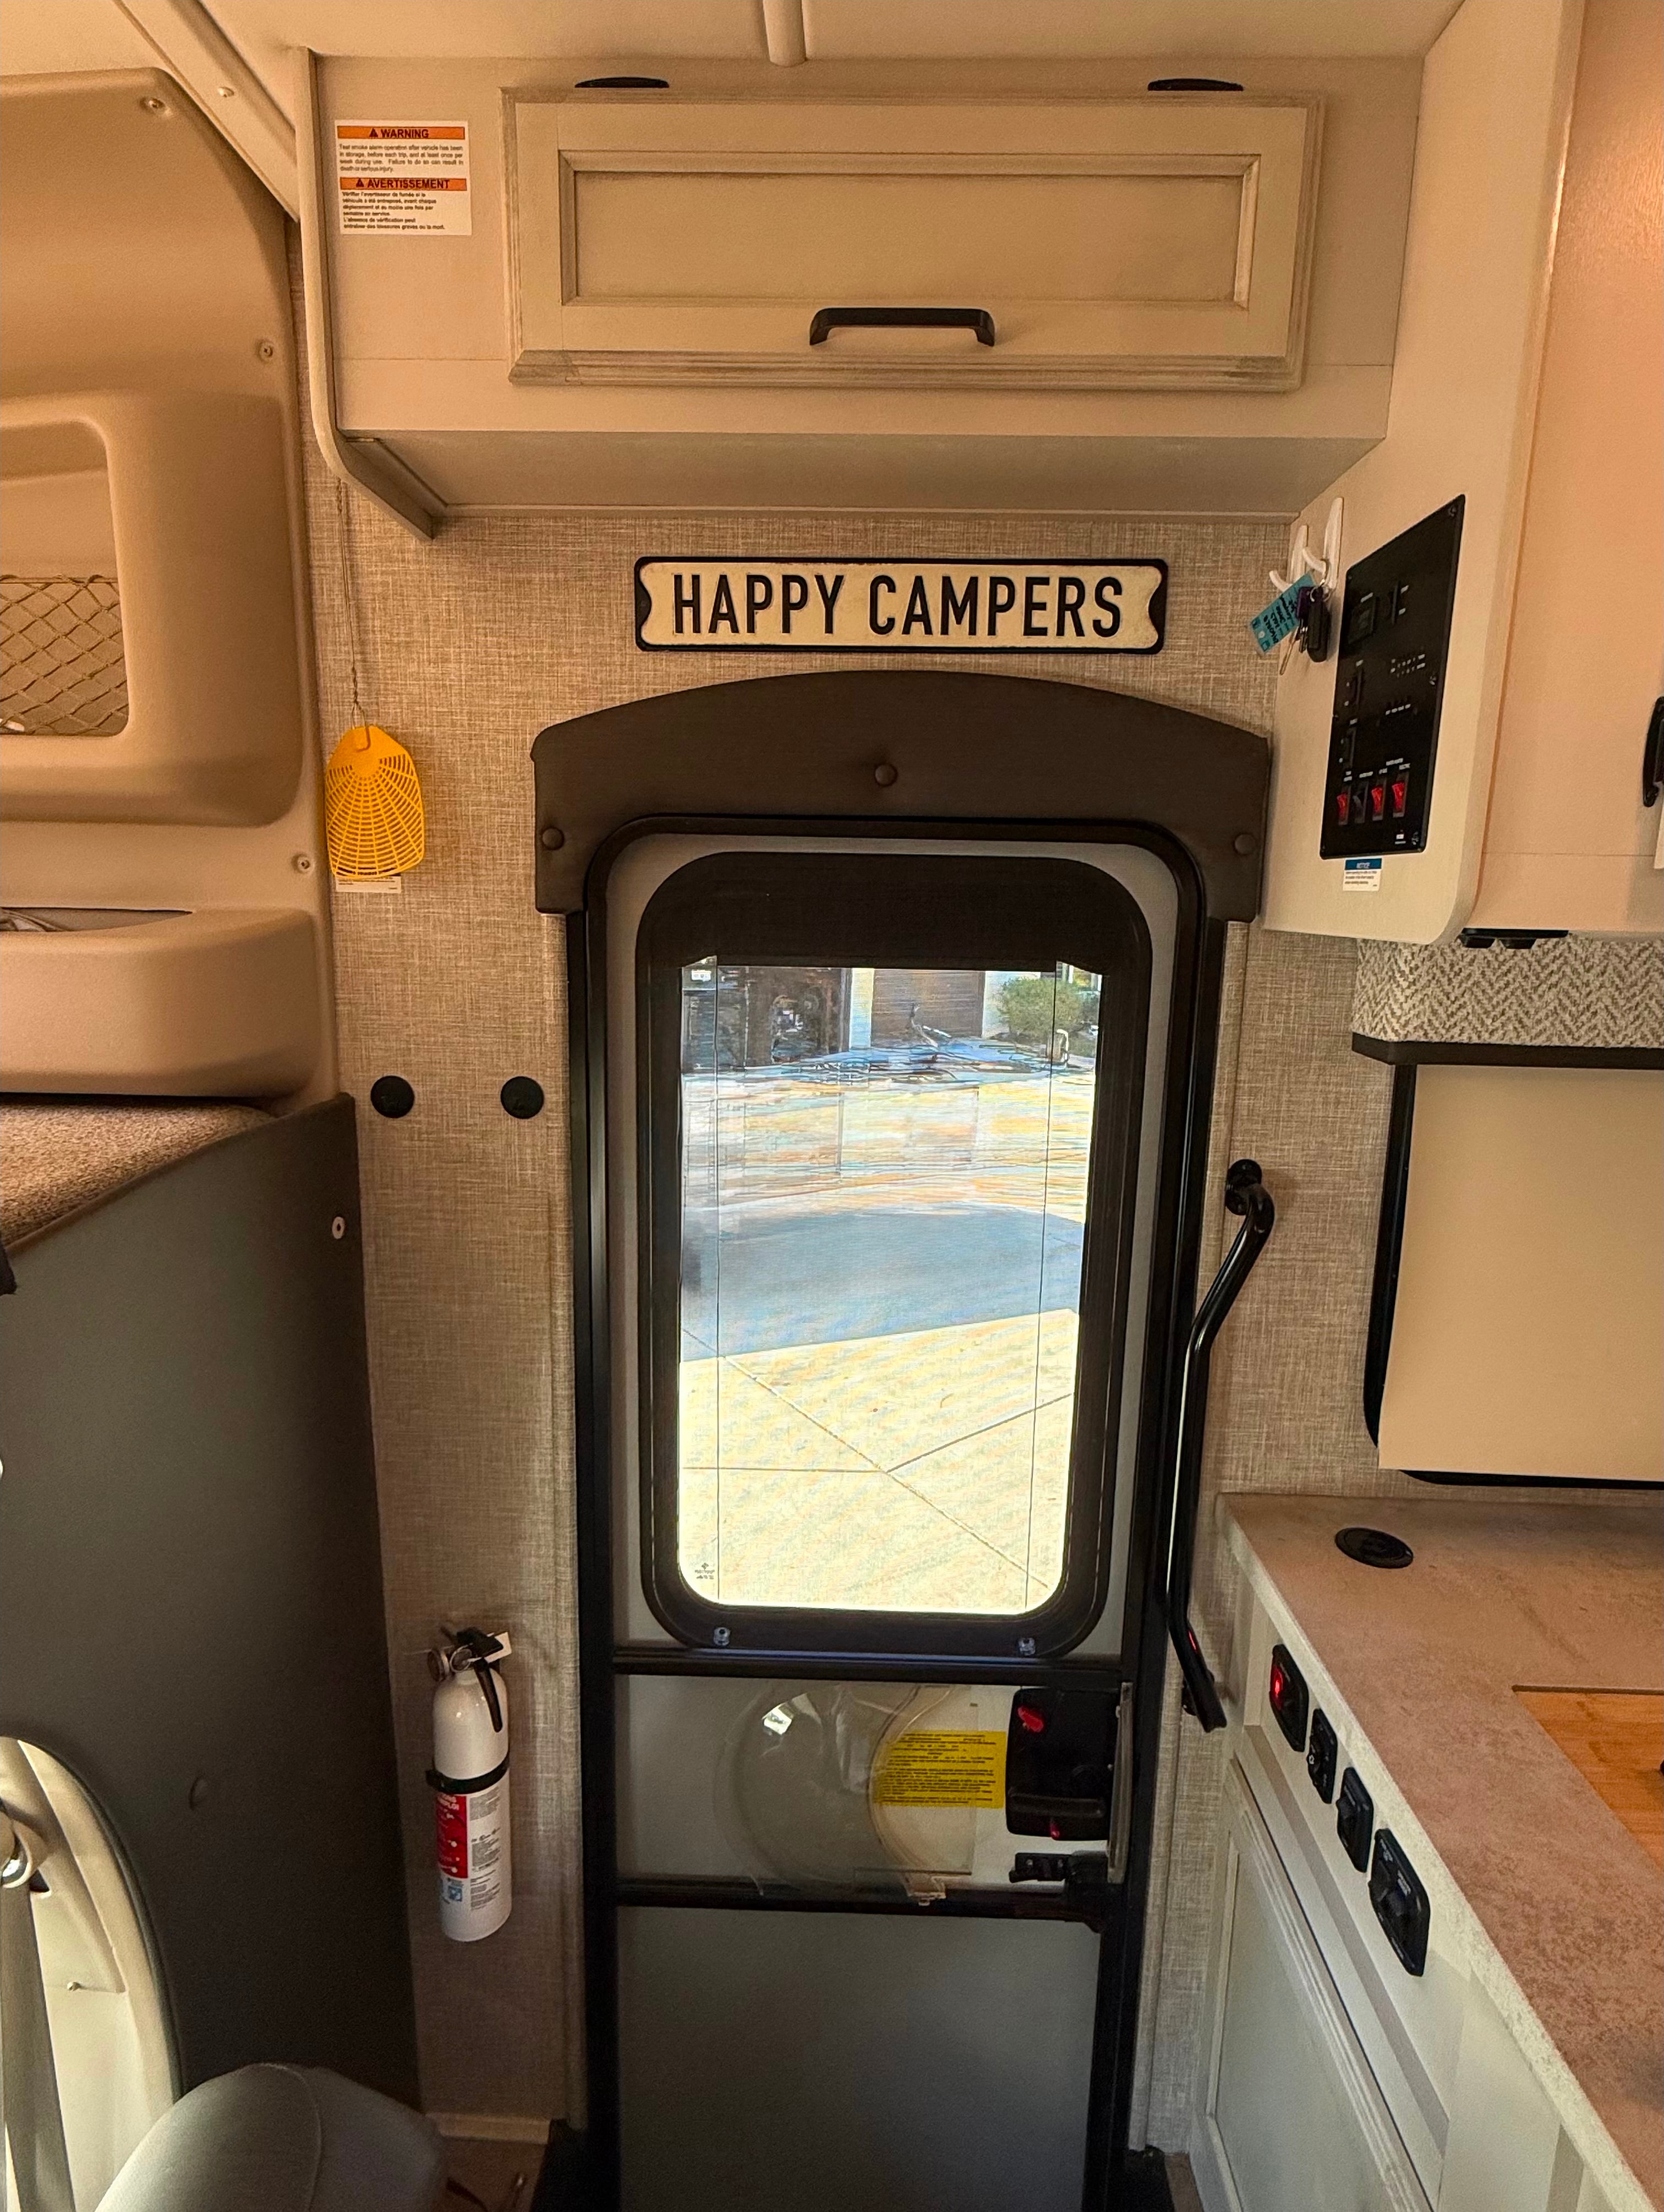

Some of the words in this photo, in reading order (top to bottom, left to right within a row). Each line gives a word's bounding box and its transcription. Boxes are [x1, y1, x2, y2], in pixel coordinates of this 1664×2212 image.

[381, 128, 429, 138] WARNING
[367, 179, 450, 189] AVERTISSEMENT
[673, 574, 844, 635] HAPPY
[868, 575, 1121, 638] CAMPERS
